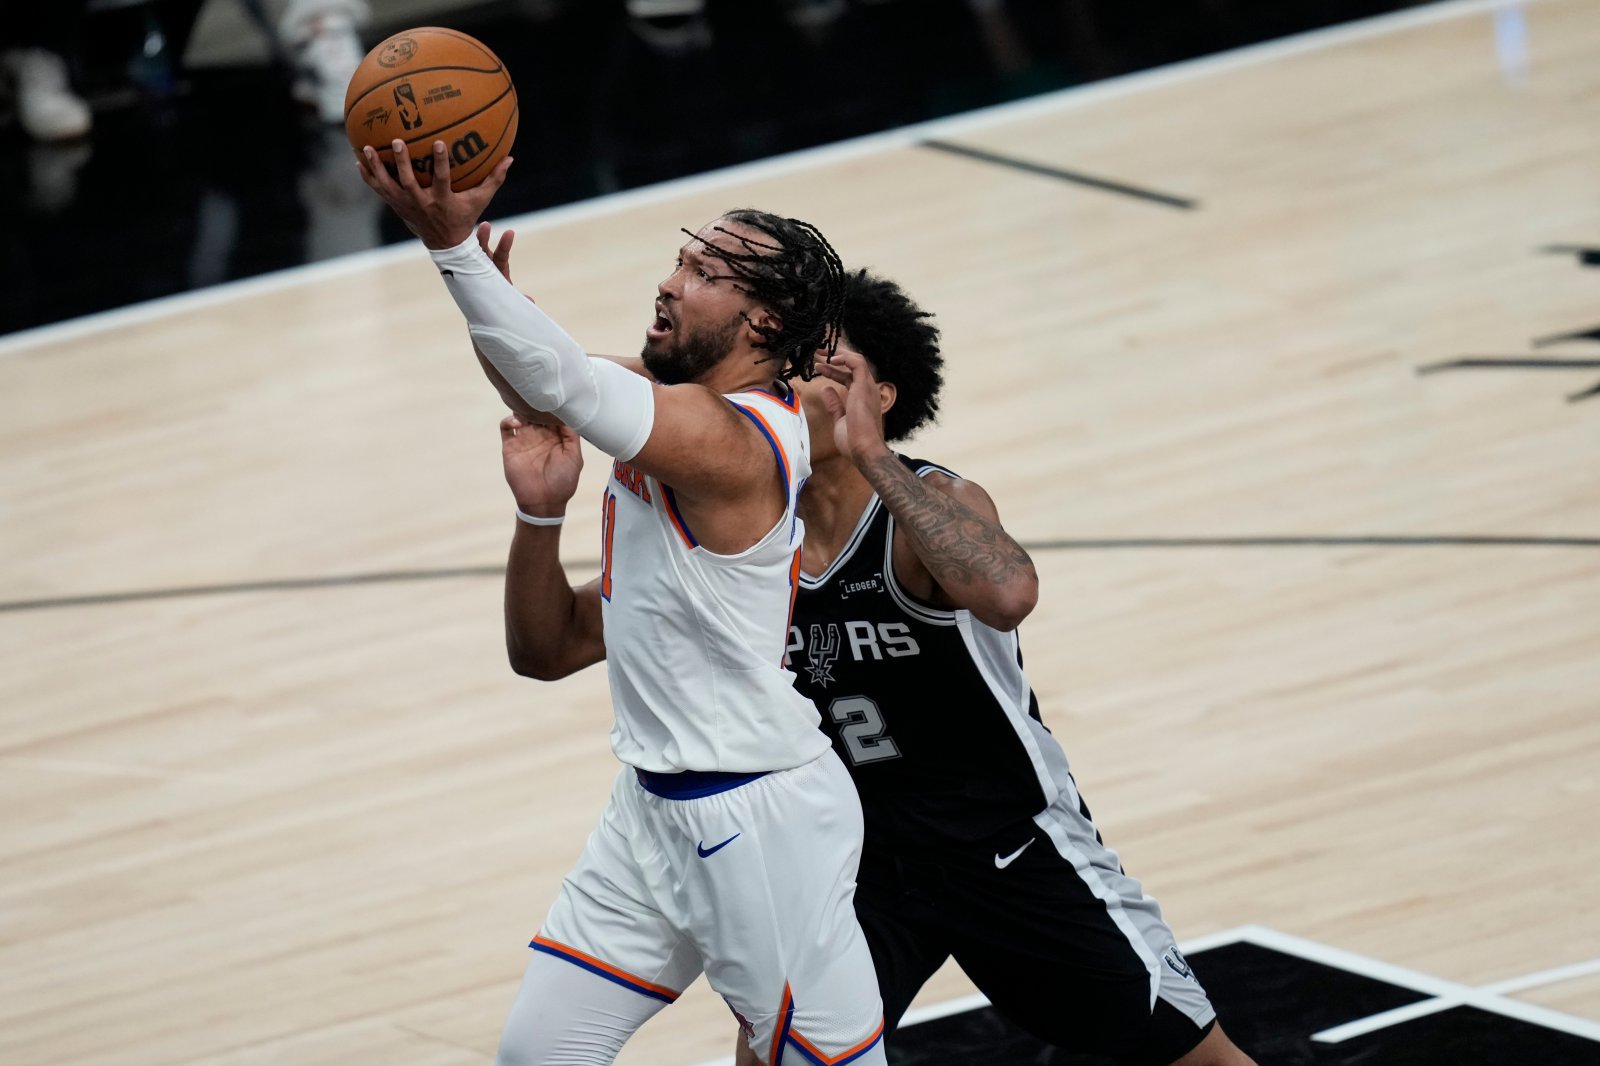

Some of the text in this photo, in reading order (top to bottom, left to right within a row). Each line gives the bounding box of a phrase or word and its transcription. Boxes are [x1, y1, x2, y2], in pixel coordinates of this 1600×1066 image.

[612, 457, 653, 506] ORK
[844, 579, 878, 594] LEDGER
[785, 620, 920, 688] PURS
[828, 694, 903, 767] 2
